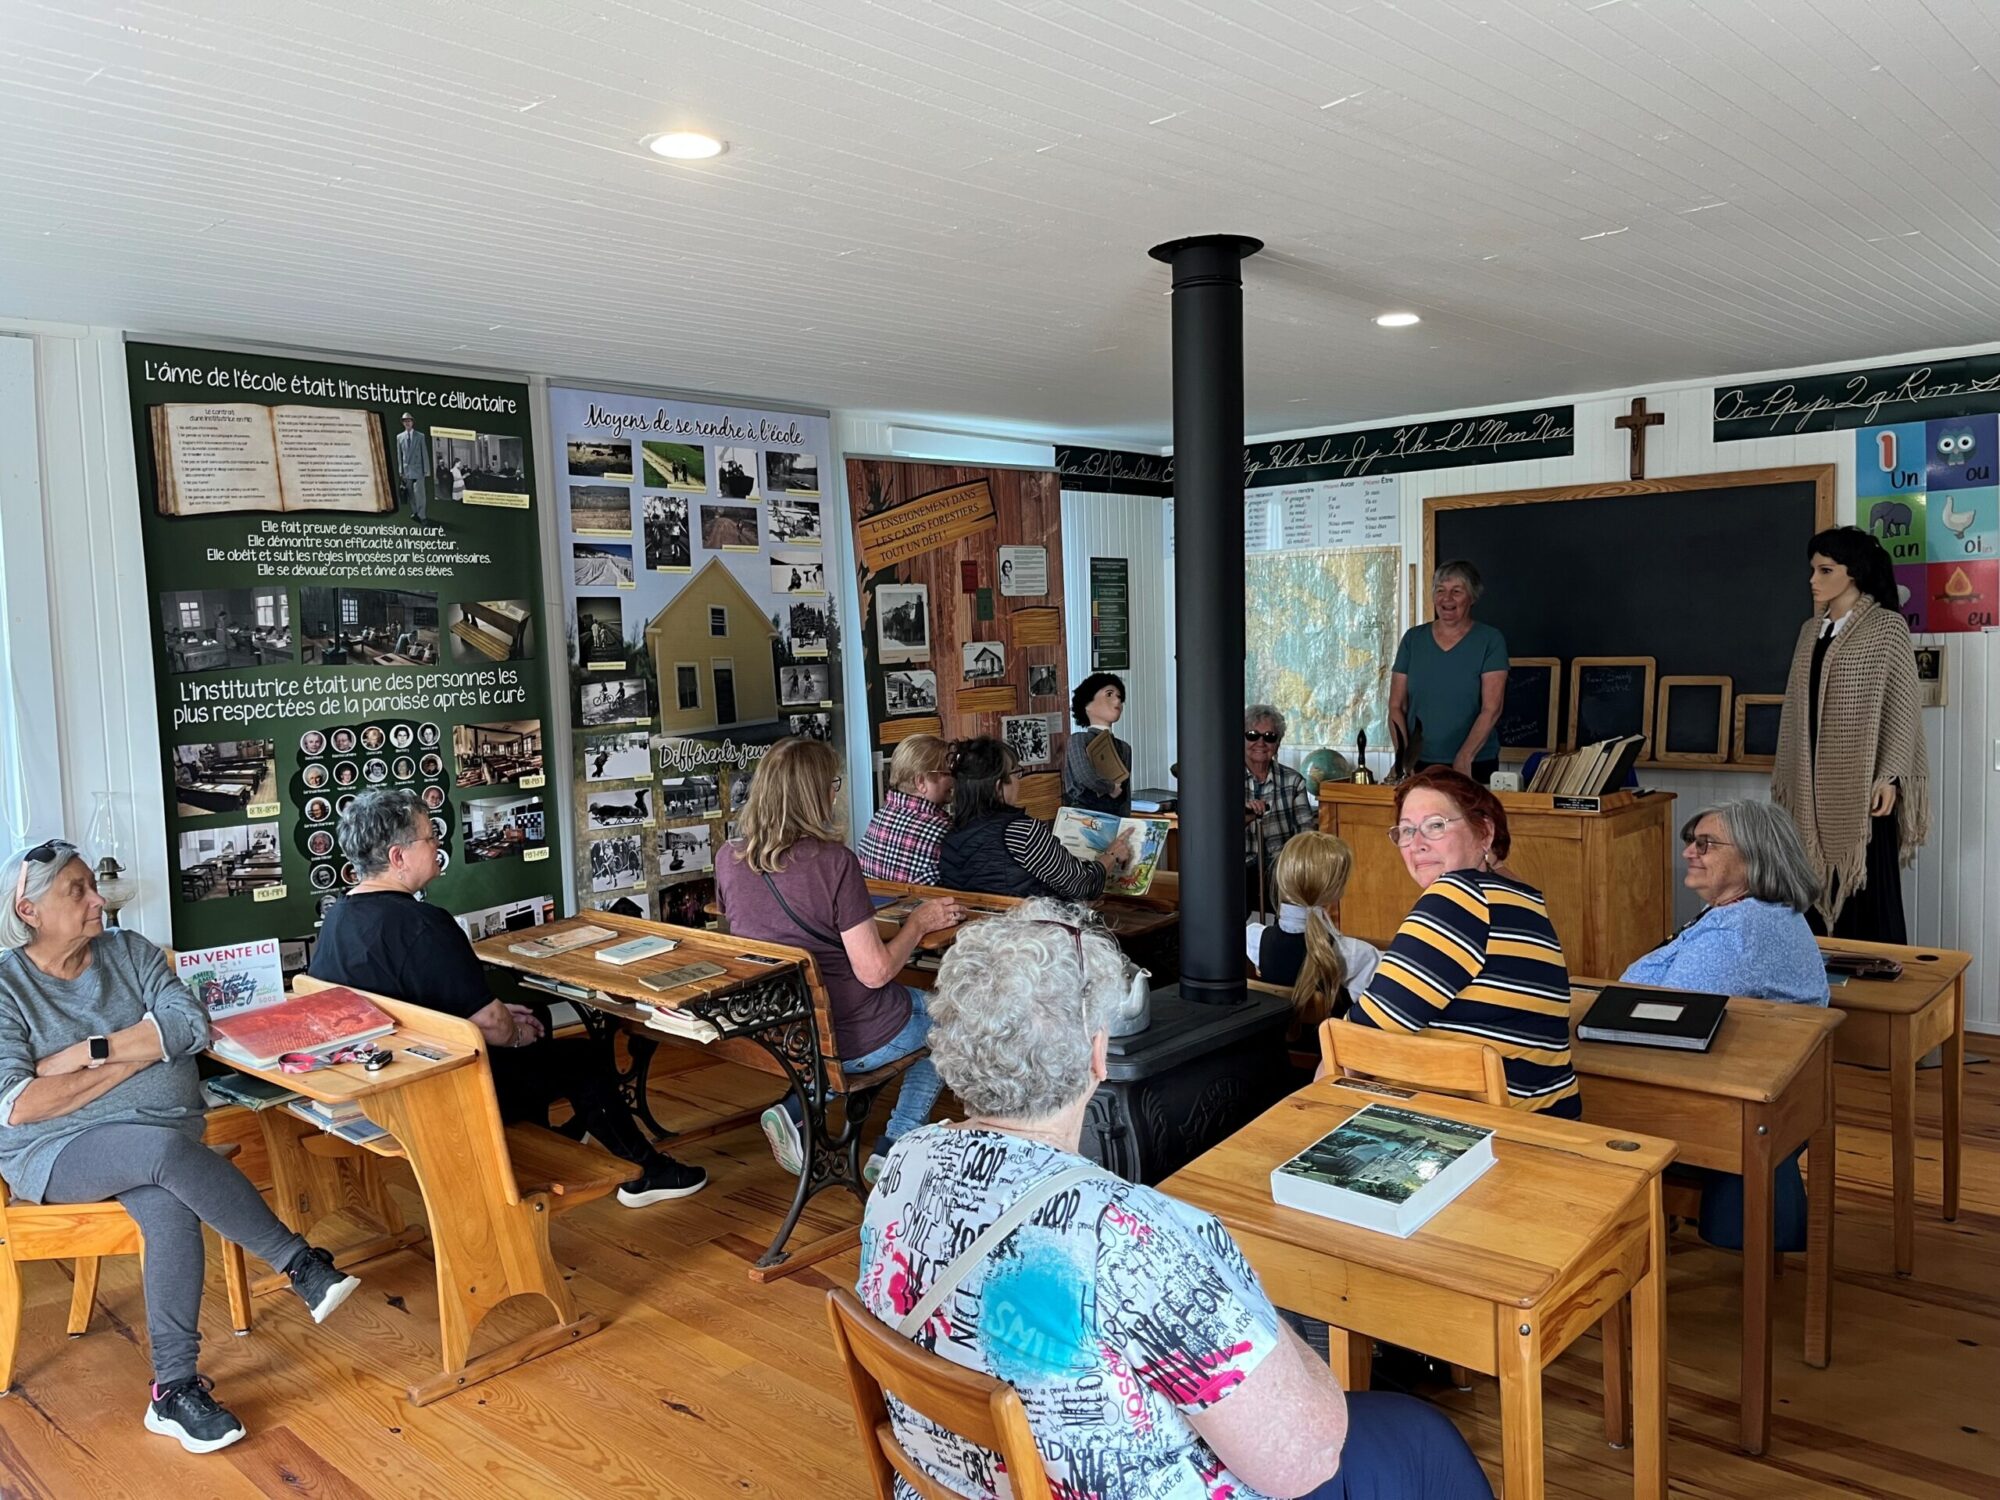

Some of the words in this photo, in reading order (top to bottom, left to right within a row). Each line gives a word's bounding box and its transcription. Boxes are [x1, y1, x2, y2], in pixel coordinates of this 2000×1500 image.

[145, 360, 203, 385] L'âme
[207, 366, 231, 388] de
[234, 368, 287, 393] l'école
[290, 375, 336, 397] était
[338, 379, 437, 407] l'institutrice
[439, 391, 517, 414] célibataire
[583, 403, 650, 438] Moyens
[653, 407, 672, 431] de
[675, 418, 693, 434] se
[695, 415, 744, 438] rendre
[747, 422, 758, 440] à
[760, 418, 804, 444] l'école
[1891, 470, 1918, 489] Un
[1966, 467, 1989, 481] ou
[871, 496, 951, 533] L'ENSEIGNEMENT
[952, 489, 976, 505] DANS
[261, 520, 279, 533] Elle
[280, 521, 301, 533] fait
[303, 524, 337, 537] preuve
[339, 523, 351, 535] de
[353, 524, 407, 535] soumission
[409, 526, 422, 536] au
[876, 534, 893, 547] LES
[895, 522, 927, 540] CAMPS
[928, 503, 980, 529] FORESTIERS
[247, 534, 265, 547] Elle
[267, 535, 322, 548] démontre
[324, 538, 344, 548] son
[345, 537, 394, 549] efficacité
[880, 544, 906, 562] TOUT
[906, 539, 920, 552] UN
[1893, 542, 1919, 558] an
[206, 548, 225, 561] Elle
[227, 549, 257, 561] obéit
[259, 549, 272, 562] et
[273, 550, 294, 562] suit
[296, 550, 311, 562] les
[312, 551, 343, 567] règles
[344, 551, 394, 566] imposées
[394, 553, 410, 566] par
[412, 552, 425, 563] les
[426, 553, 492, 564] commissaires.
[257, 563, 275, 576] Elle
[276, 565, 290, 576] se
[291, 564, 328, 576] dévoue
[329, 566, 360, 579] corps
[361, 565, 373, 576] et
[374, 565, 397, 576] âme
[398, 565, 406, 576] à
[407, 566, 424, 576] ses
[425, 565, 455, 577] élèves.
[1968, 611, 1991, 626] eu
[180, 678, 300, 701] L'institutrice
[303, 675, 348, 695] était
[351, 676, 382, 692] une
[385, 673, 414, 691] des
[417, 670, 495, 694] personnes
[498, 667, 518, 685] les
[173, 704, 210, 731] plus
[212, 699, 316, 726] respectées
[319, 696, 341, 715] de
[343, 696, 359, 713] la
[362, 693, 430, 718] paroisse
[433, 689, 477, 713] après
[479, 688, 491, 705] le
[493, 686, 526, 704] curé
[659, 739, 739, 771] Différents
[180, 954, 200, 967] EN
[204, 946, 252, 963] VENTE
[256, 943, 275, 955] ICI
